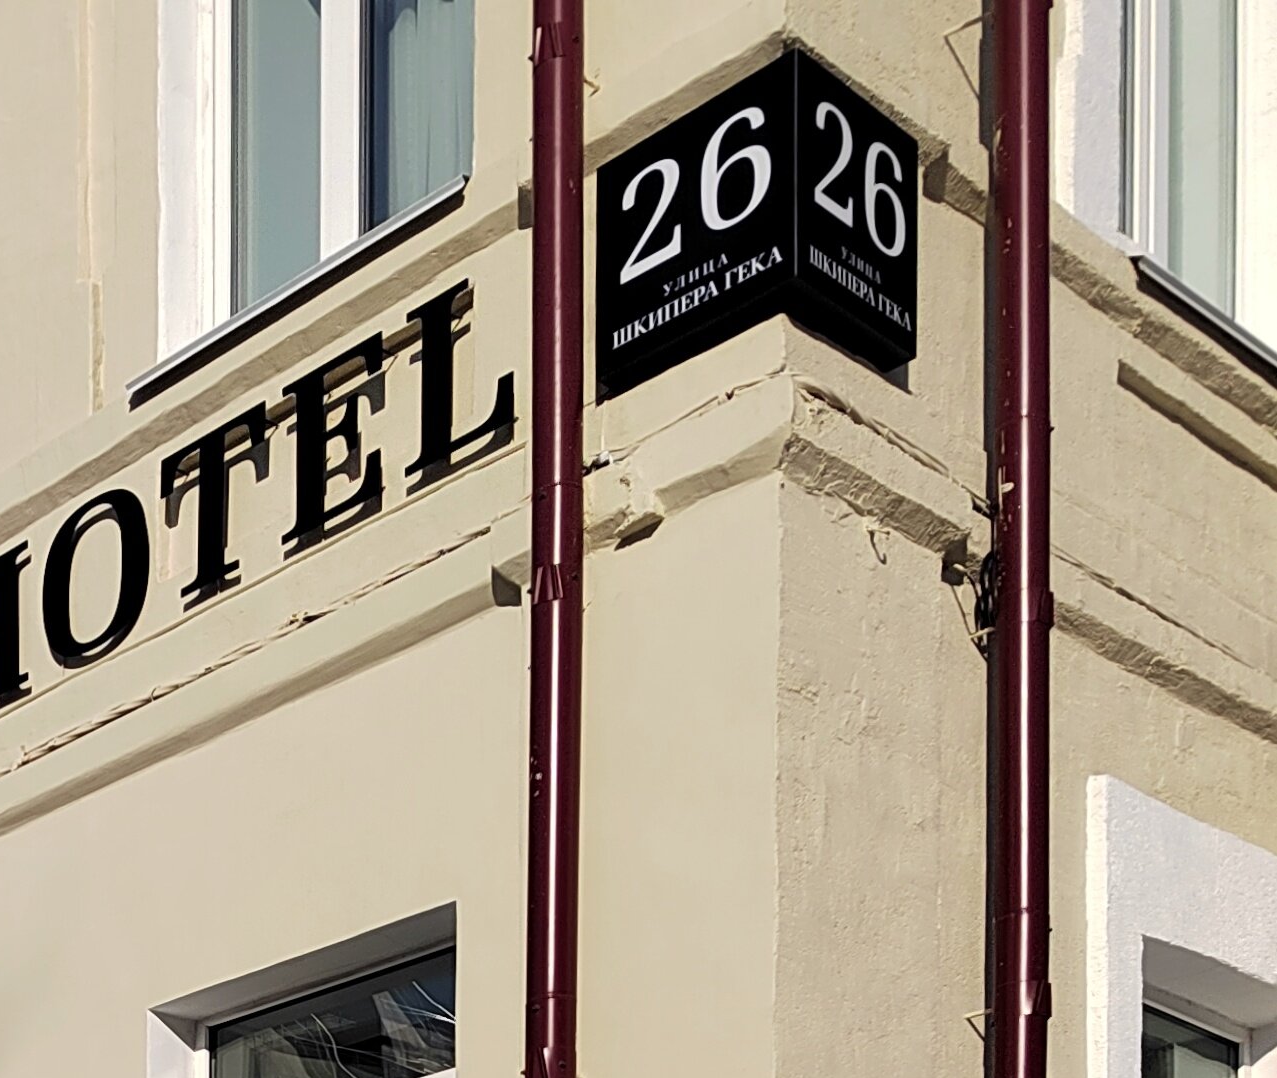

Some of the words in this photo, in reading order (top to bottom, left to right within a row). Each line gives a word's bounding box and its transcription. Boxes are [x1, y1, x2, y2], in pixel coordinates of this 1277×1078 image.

[620, 106, 772, 285] 26
[814, 101, 906, 257] 26
[612, 280, 719, 350] ШКИПЕРА
[724, 246, 783, 291] ГЕКА
[662, 253, 728, 297] УЛИЦА
[809, 244, 876, 307] ШКИПЕРА
[878, 296, 912, 332] ГЕКА
[841, 246, 882, 284] УЛИЦА
